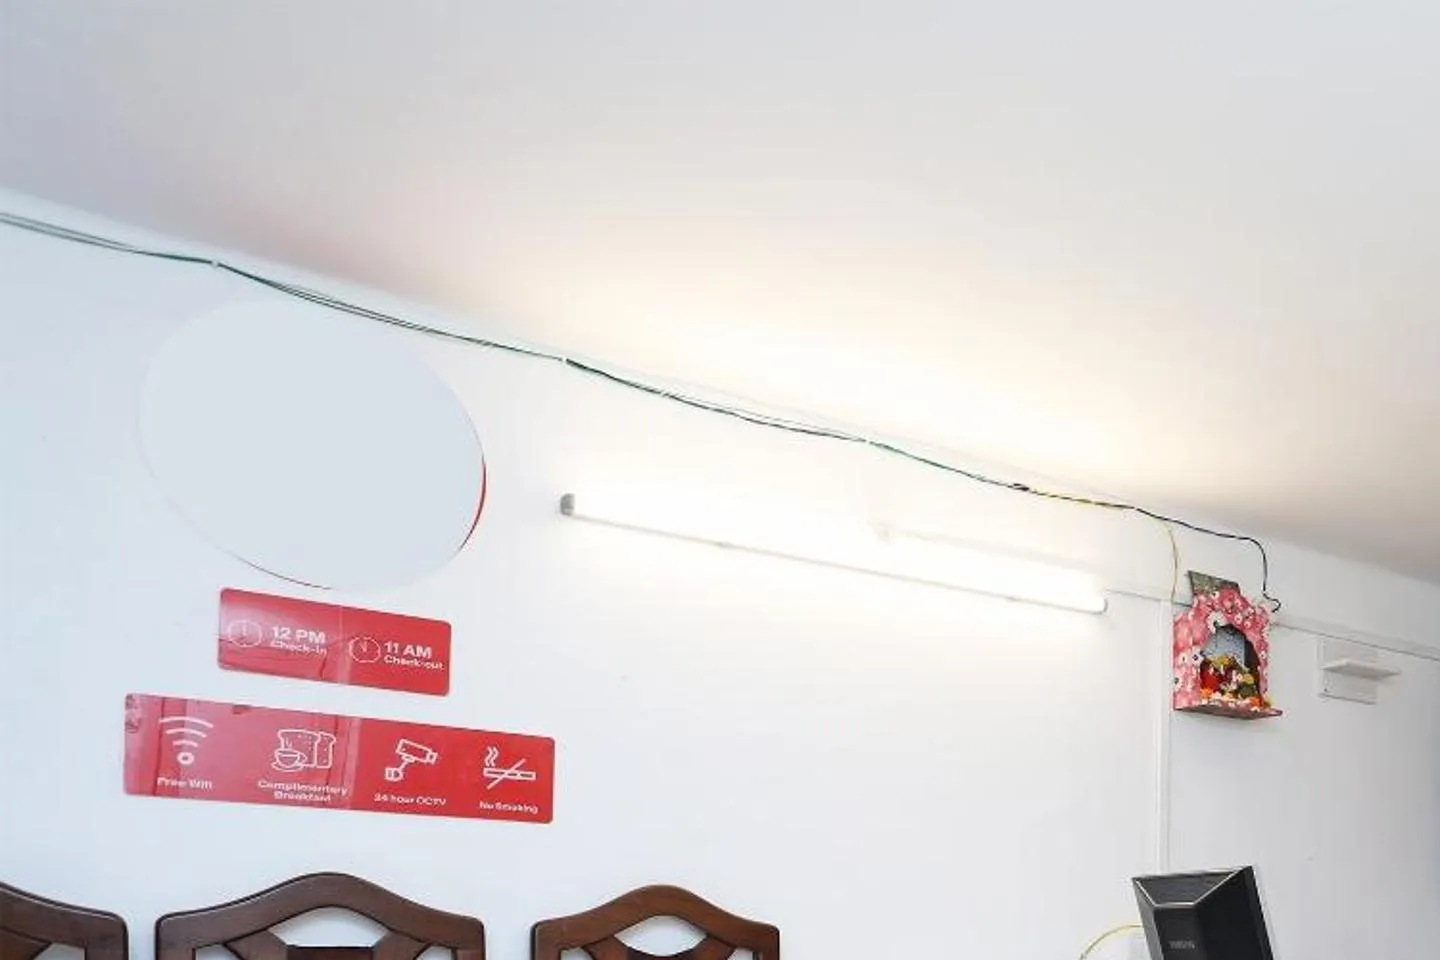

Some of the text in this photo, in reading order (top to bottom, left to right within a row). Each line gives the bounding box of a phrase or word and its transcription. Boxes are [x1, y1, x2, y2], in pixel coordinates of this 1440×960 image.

[271, 626, 326, 645] 12 PM
[383, 641, 432, 659] 11 AM
